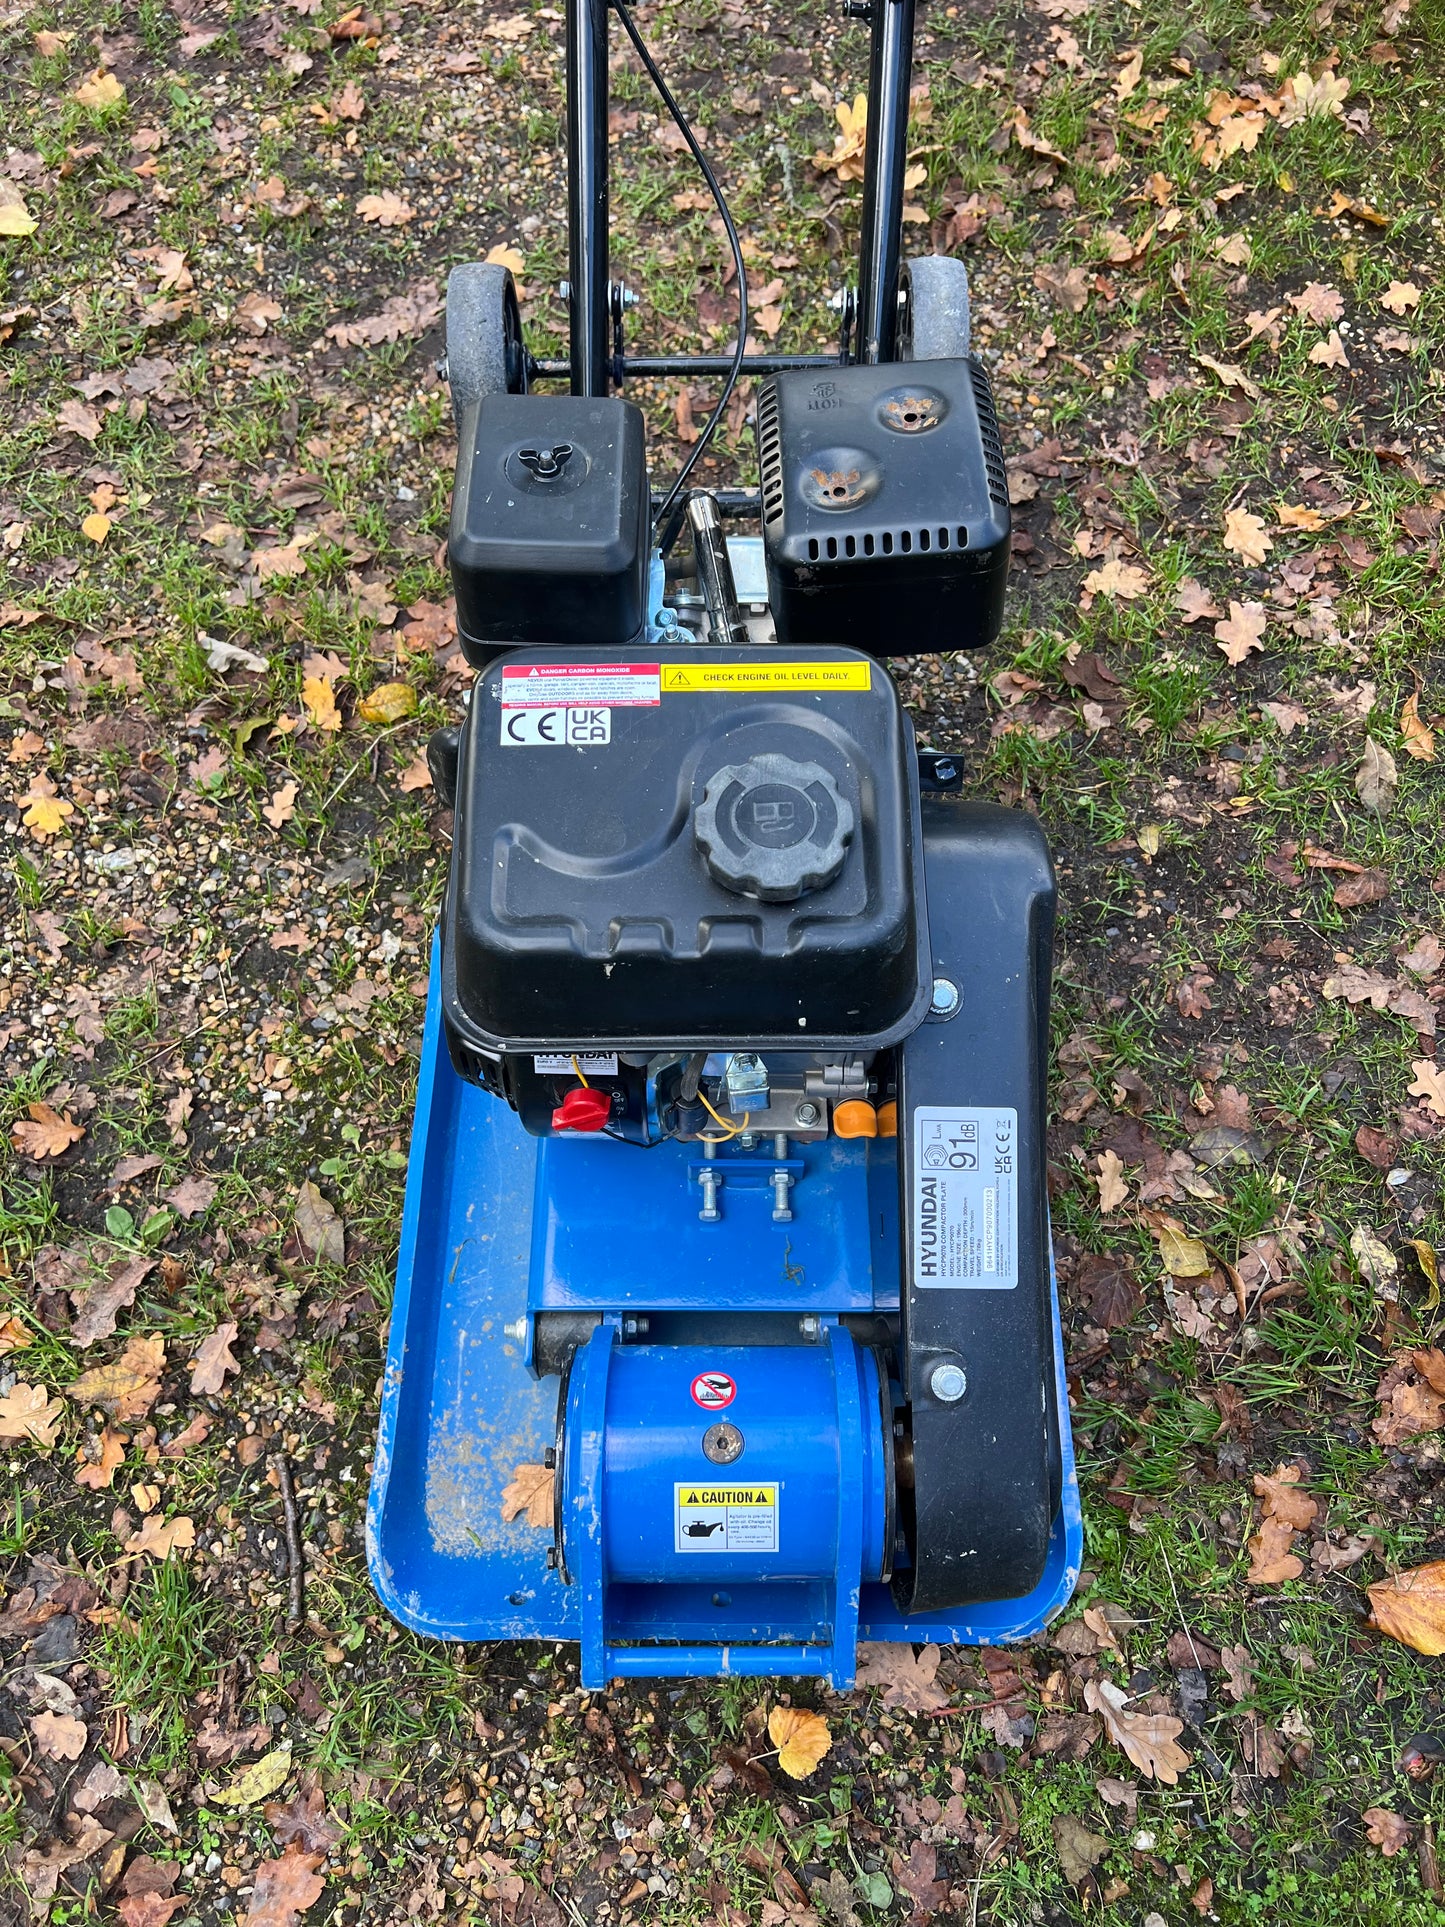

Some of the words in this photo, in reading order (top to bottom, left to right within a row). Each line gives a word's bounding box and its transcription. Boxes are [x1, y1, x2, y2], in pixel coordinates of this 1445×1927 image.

[703, 673, 735, 682] CHECK
[737, 673, 770, 681] ENGINE
[774, 672, 789, 680] OIL
[792, 672, 820, 680] LEVEL
[823, 672, 850, 680] DAILY.
[572, 709, 606, 725] UK
[508, 711, 556, 742] CE
[572, 726, 606, 741] CA
[994, 1156, 1003, 1174] UK
[1003, 1156, 1012, 1174] CA
[921, 1177, 938, 1277] HYUNDAI
[701, 1491, 753, 1504] CAUTION
